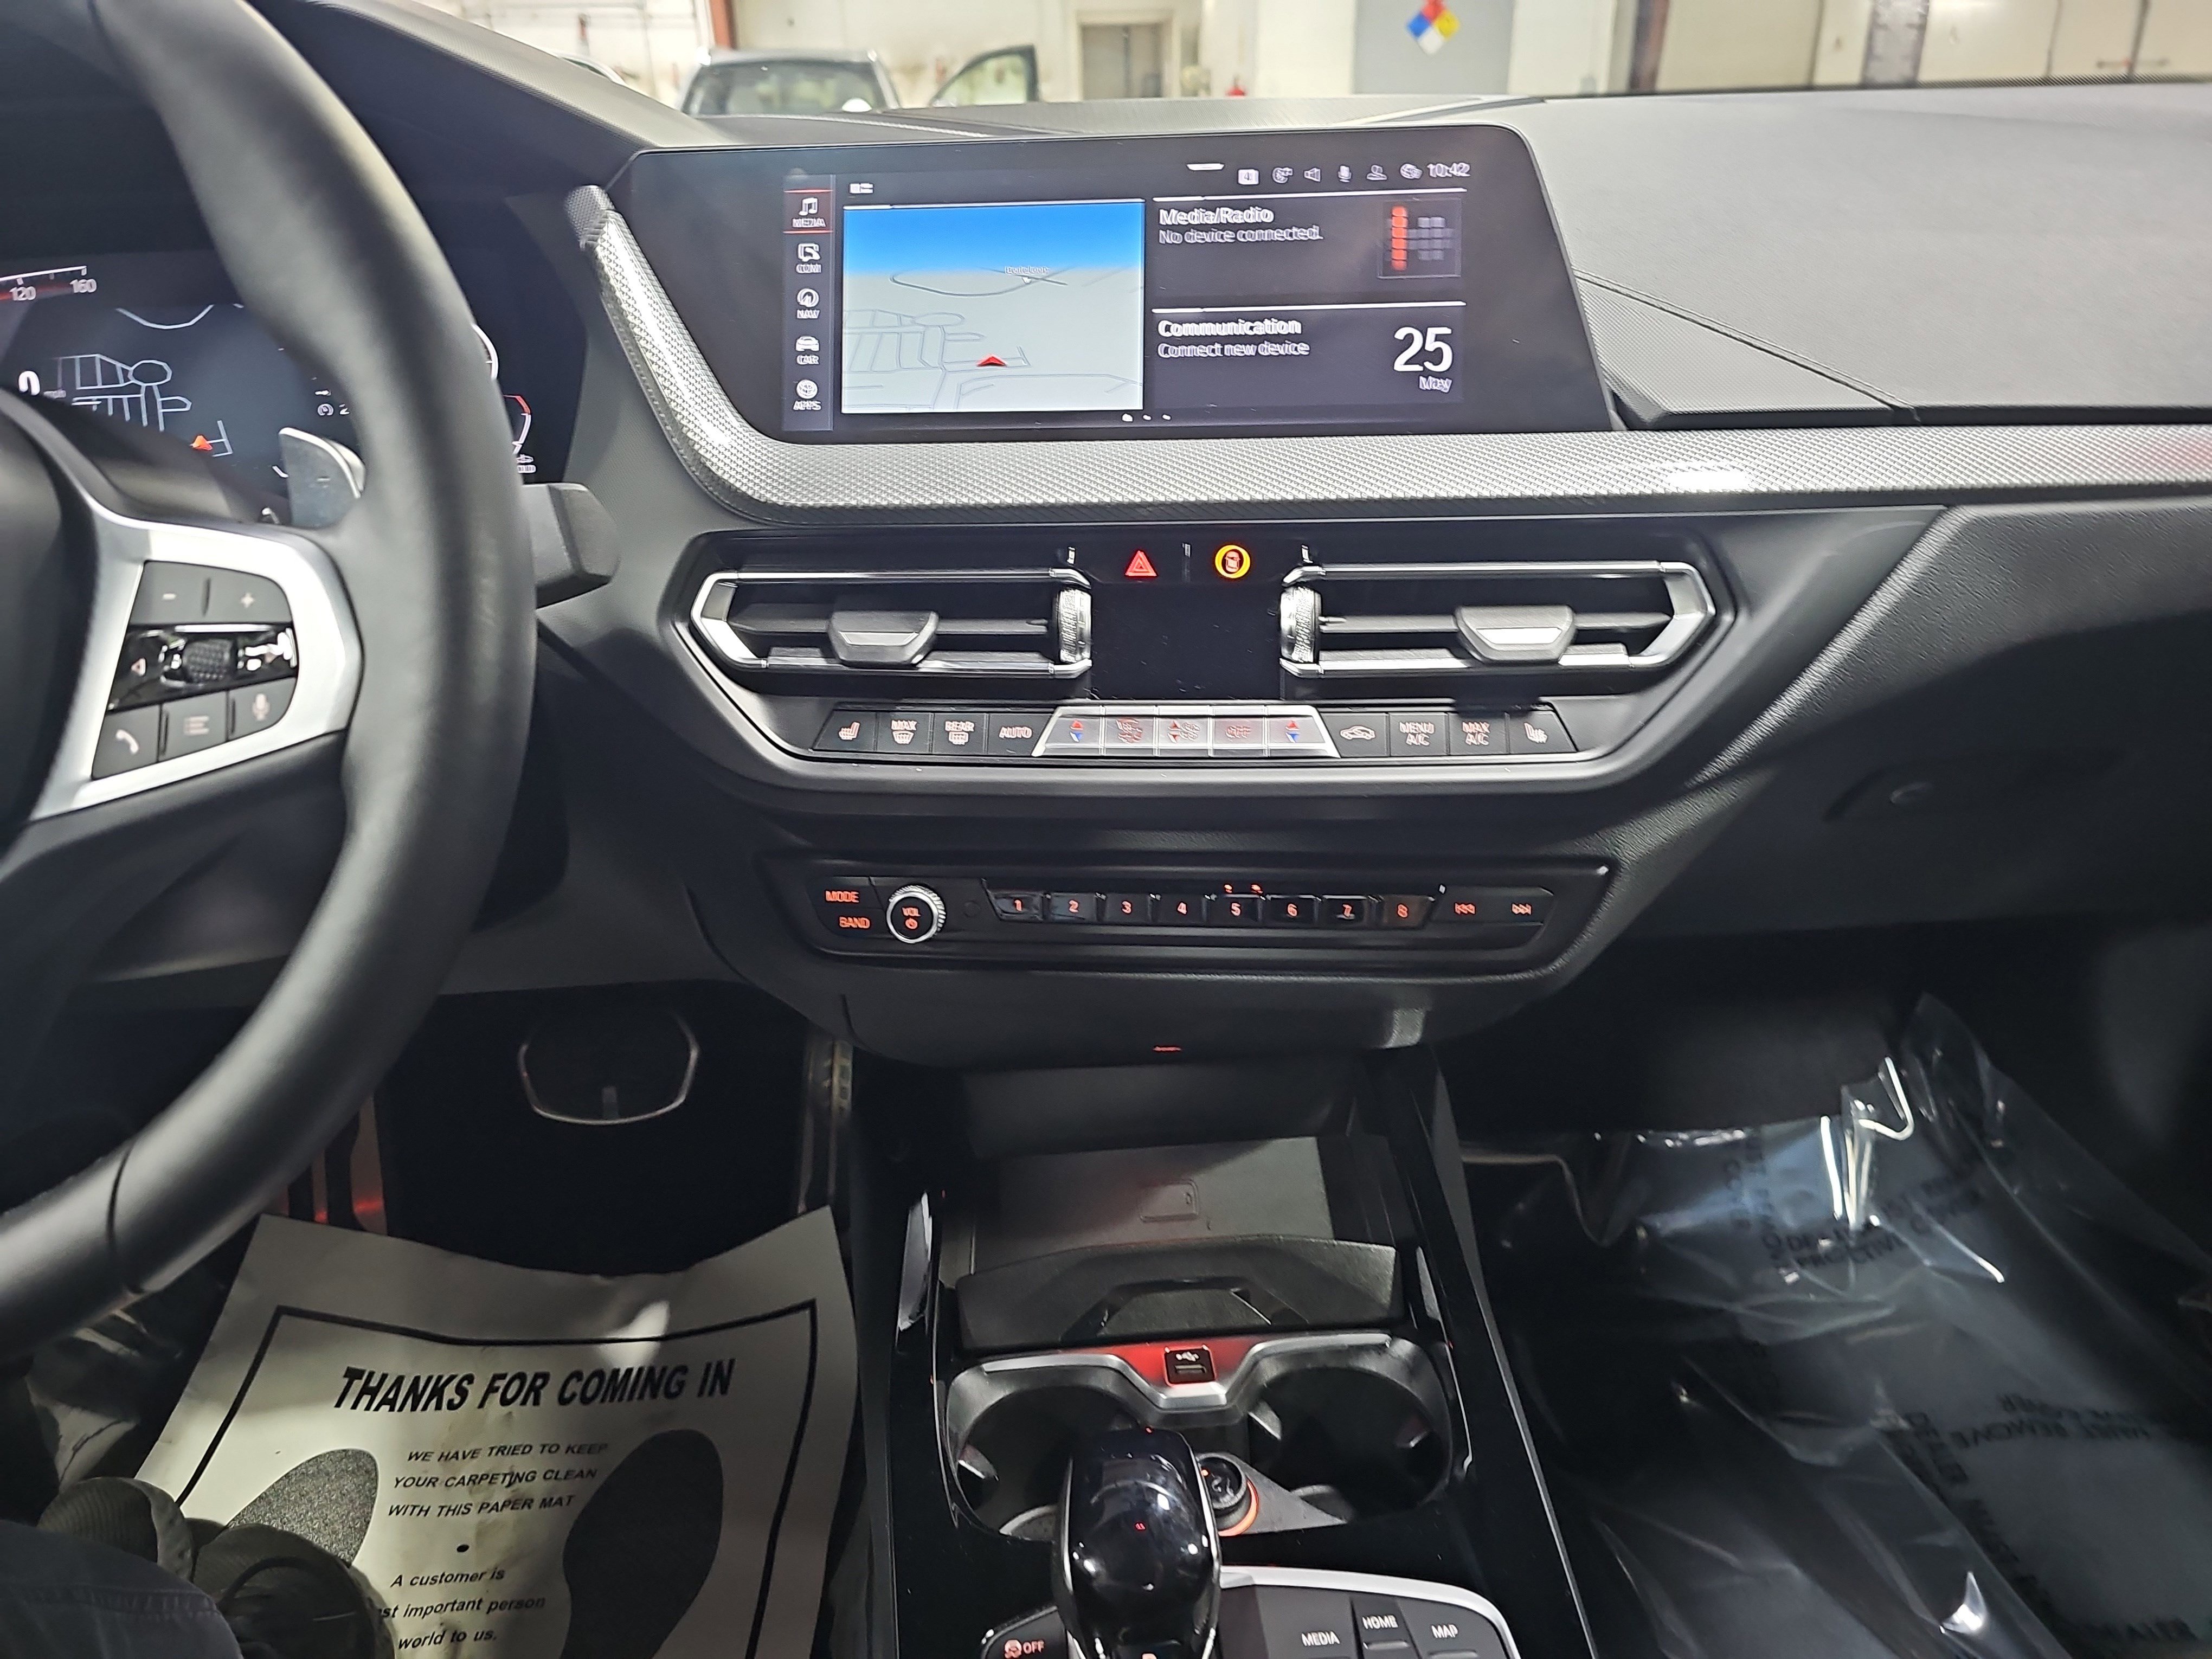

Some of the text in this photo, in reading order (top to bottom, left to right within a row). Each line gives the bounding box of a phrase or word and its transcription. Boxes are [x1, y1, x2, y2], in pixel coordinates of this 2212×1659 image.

[1159, 207, 1275, 225] Media/Radio
[1159, 226, 1324, 243] No device connected.
[69, 278, 97, 293] 160
[9, 286, 36, 301] 120
[1158, 319, 1302, 337] Communication
[1158, 342, 1309, 358] Connect new device
[1393, 326, 1454, 372] 25
[1419, 376, 1452, 393] May
[999, 726, 1032, 738] AUTO
[825, 890, 859, 903] MODE
[1014, 899, 1022, 911] 1
[1069, 900, 1079, 913] 2
[1122, 901, 1132, 914] 3
[1177, 902, 1187, 915] 4
[1231, 903, 1241, 916] 5
[1287, 903, 1297, 917] 6
[1342, 904, 1352, 917] 7
[1398, 904, 1409, 918] 8
[839, 917, 870, 929] BAND
[334, 1358, 736, 1412] THANKS FOR COMING IN
[408, 1443, 608, 1462] WE HAVE TRIED TO KEEP
[394, 1468, 598, 1488] YOUR CARPETING CLEAN
[388, 1495, 577, 1517] WITH THIS PAPER MAT
[390, 1567, 505, 1587] A customer is
[403, 1599, 484, 1619] important
[486, 1598, 546, 1614] person
[1362, 1615, 1398, 1629] HOME
[1301, 1631, 1340, 1646] MEDIA
[1431, 1624, 1458, 1638] MAP
[398, 1630, 497, 1649] world to us.
[1023, 1639, 1045, 1654] OFF
